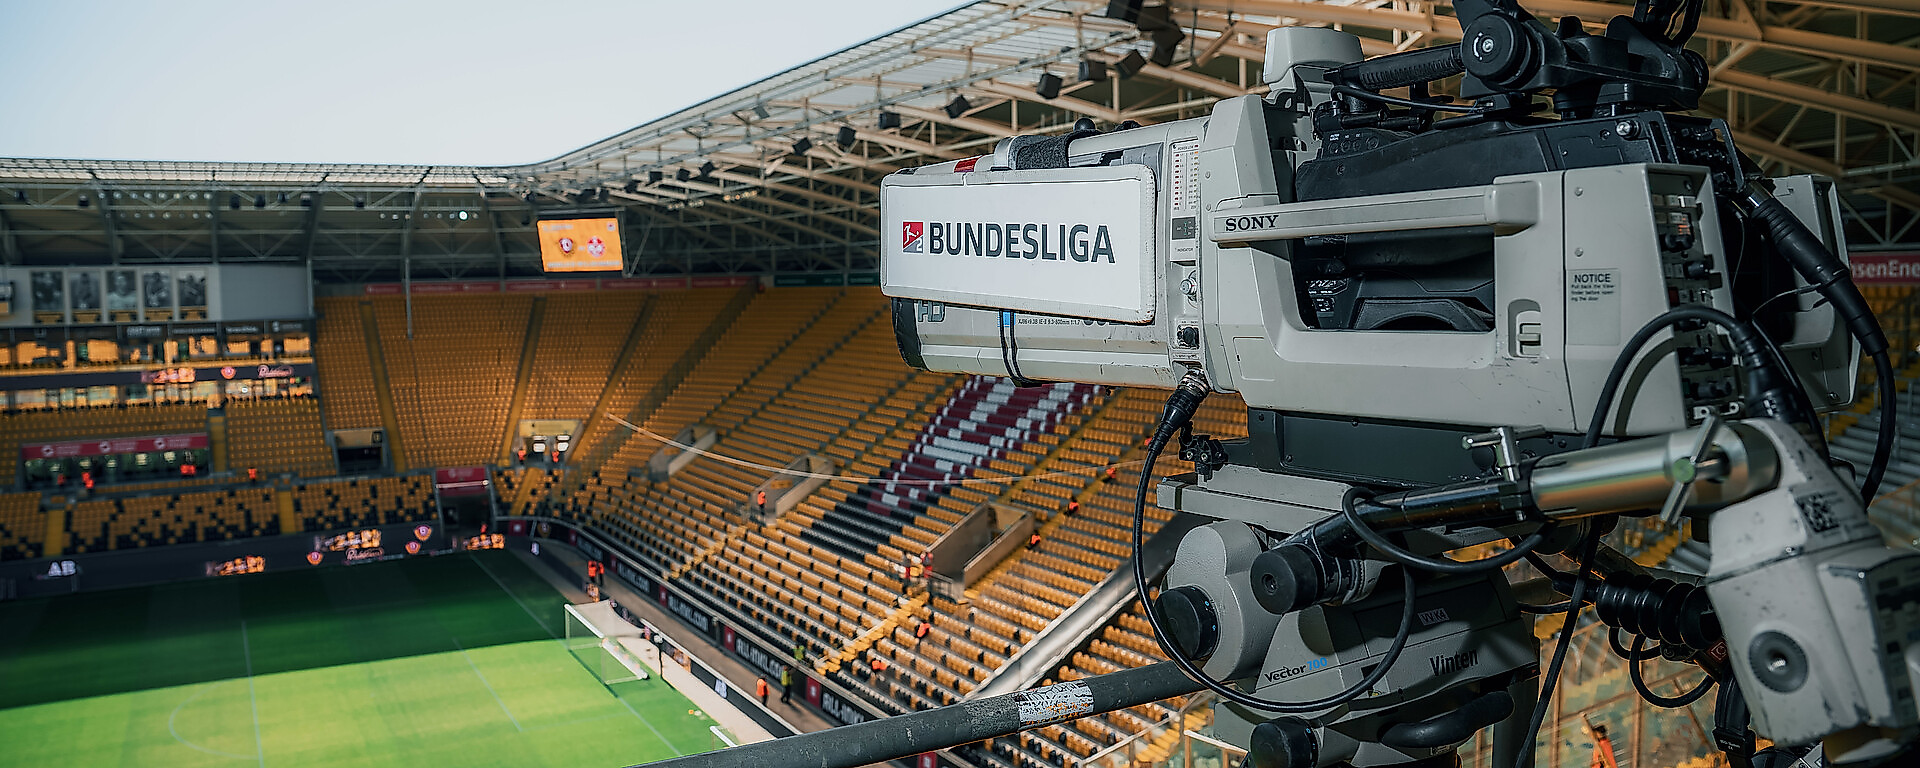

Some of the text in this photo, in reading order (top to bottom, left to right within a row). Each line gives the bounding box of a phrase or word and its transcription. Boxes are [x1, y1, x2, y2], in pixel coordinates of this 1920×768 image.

[1225, 215, 1279, 231] SONY
[916, 222, 1115, 264] 2 BUNDESLIGA
[1574, 273, 1611, 283] NOTICE
[1264, 657, 1328, 682] Vector 700
[1430, 649, 1479, 676] Vinten
